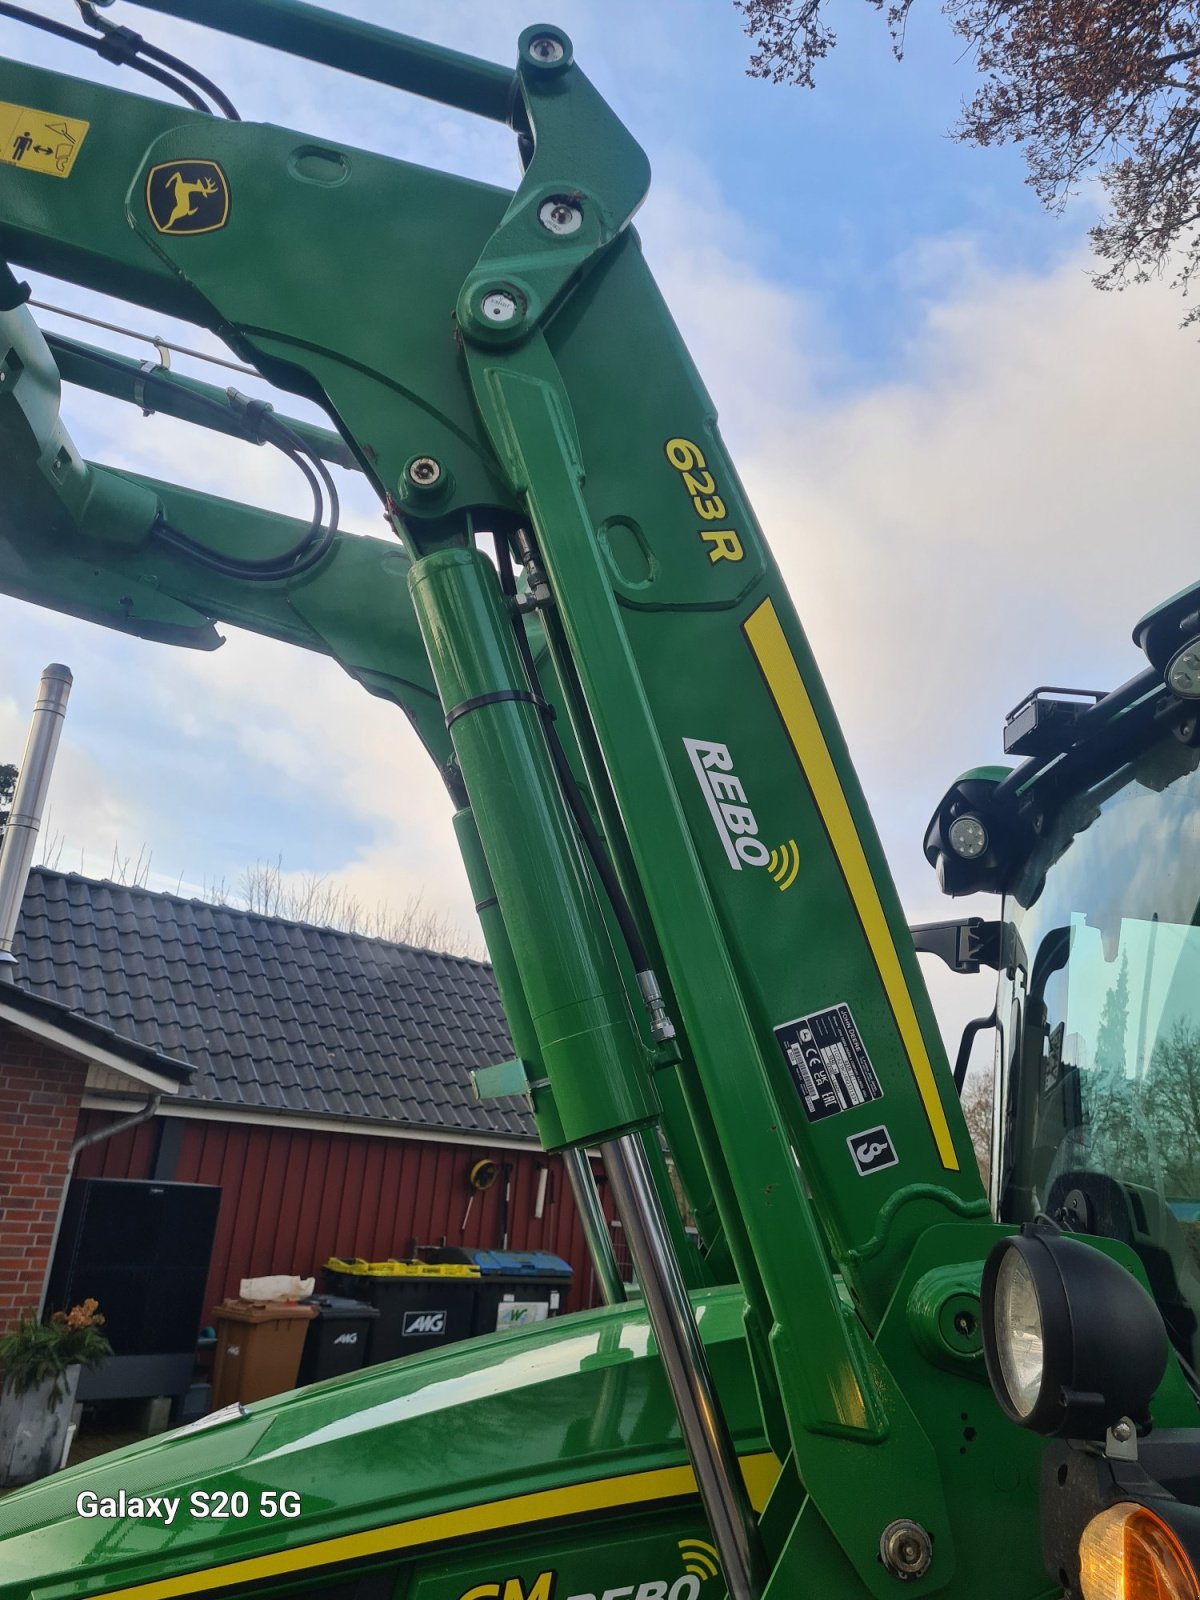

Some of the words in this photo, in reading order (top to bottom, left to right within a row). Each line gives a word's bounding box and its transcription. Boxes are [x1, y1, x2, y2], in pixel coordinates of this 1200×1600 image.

[682, 737, 770, 870] REBO
[841, 1010, 851, 1028] JOHN
[849, 1029, 861, 1051] DEERE
[814, 1072, 823, 1086] CA
[820, 1070, 828, 1084] UK
[405, 1314, 443, 1332] AWG
